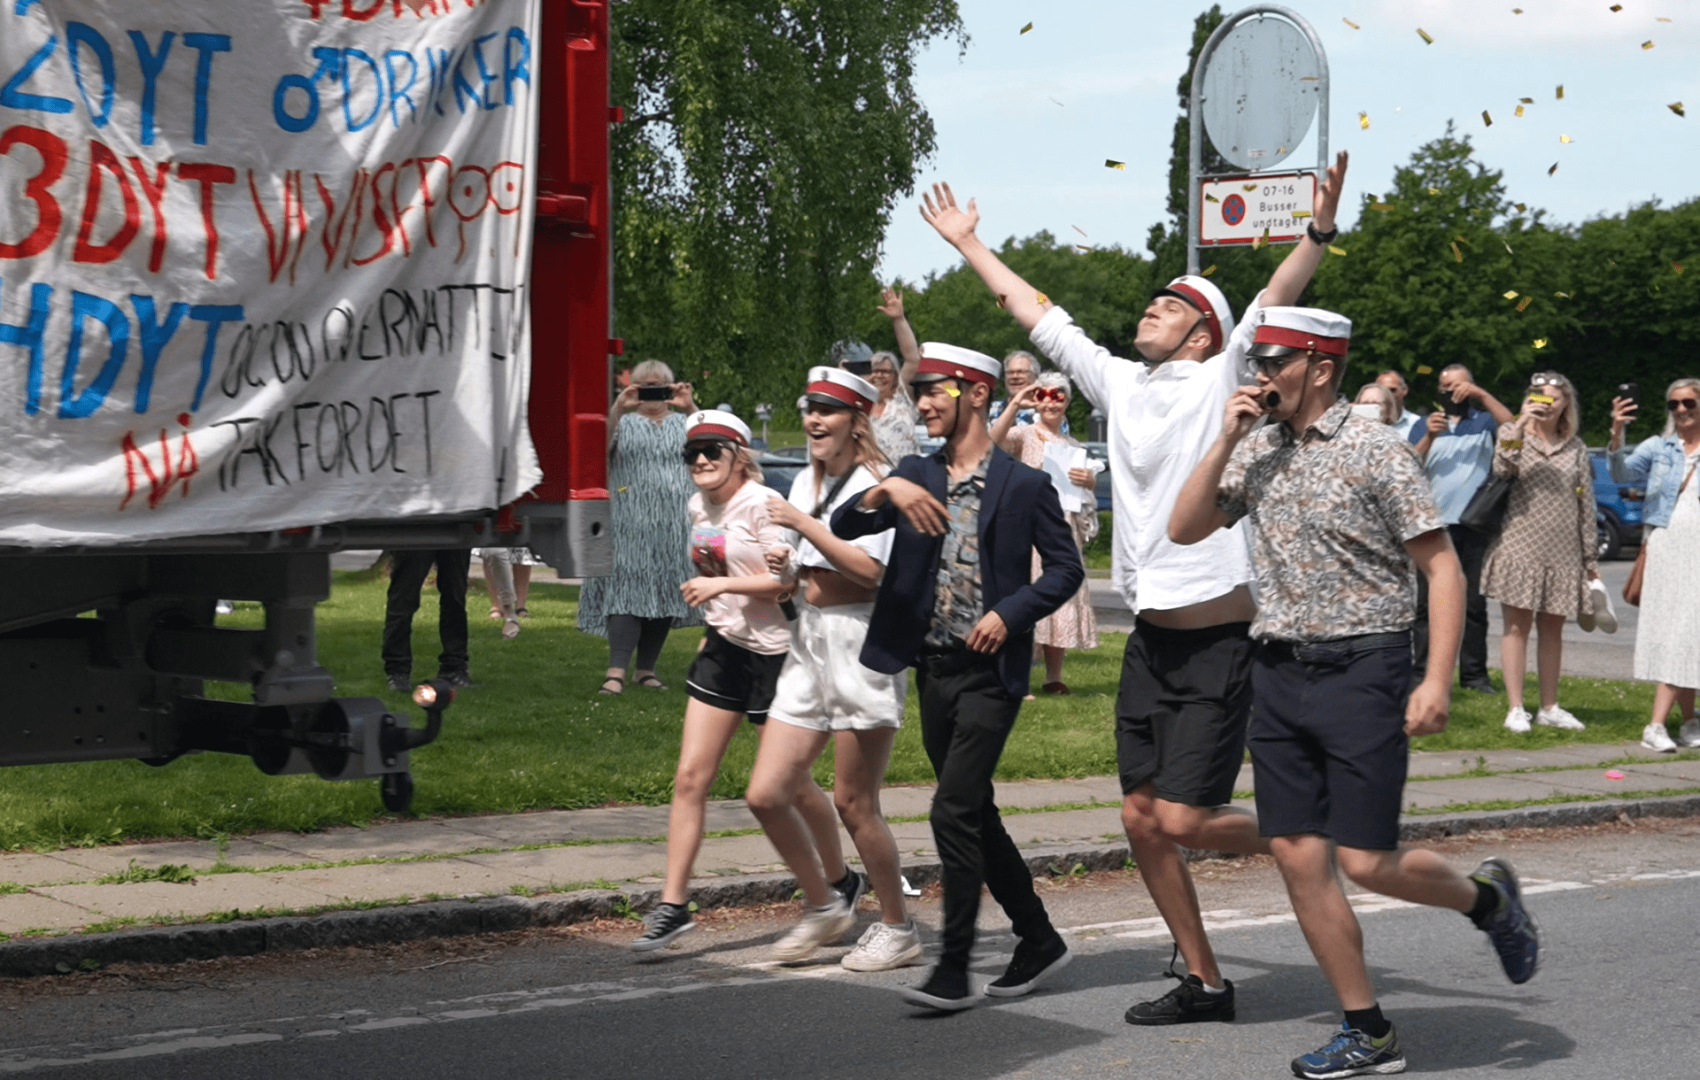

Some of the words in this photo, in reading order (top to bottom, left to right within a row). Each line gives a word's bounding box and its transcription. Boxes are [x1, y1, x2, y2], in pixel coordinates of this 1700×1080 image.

[1263, 184, 1294, 197] 07-16
[1259, 202, 1297, 212] Busser
[1252, 217, 1304, 229] undtaget
